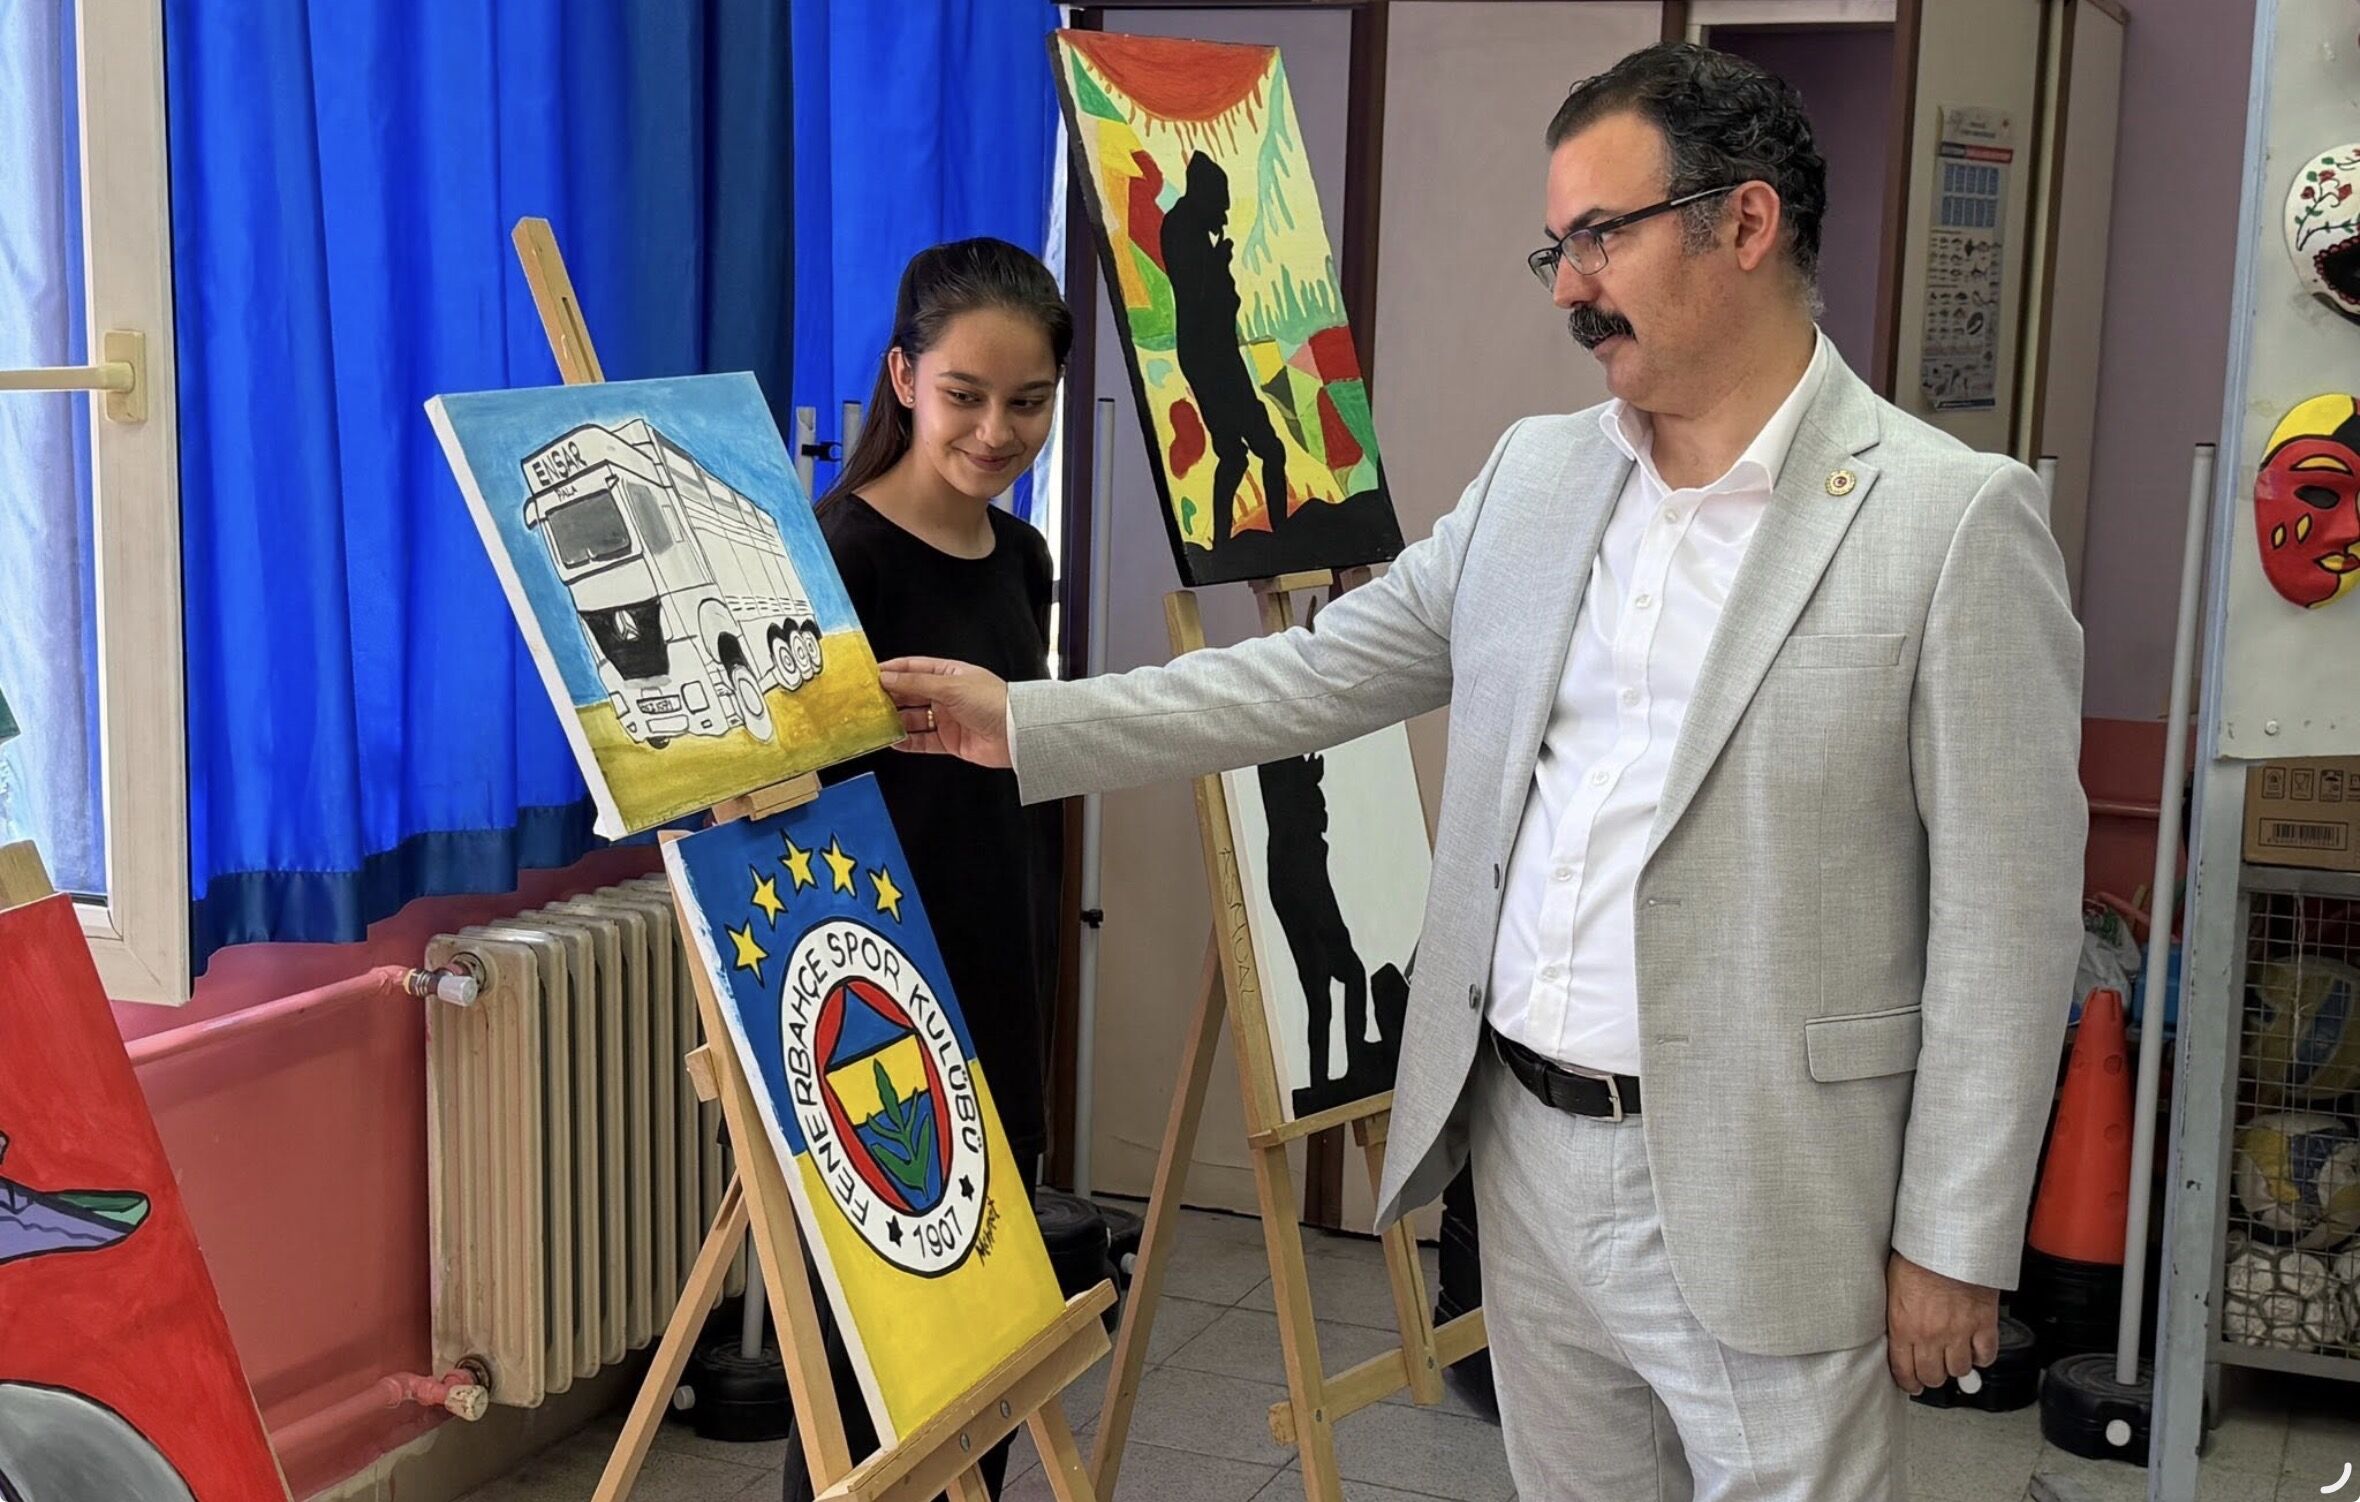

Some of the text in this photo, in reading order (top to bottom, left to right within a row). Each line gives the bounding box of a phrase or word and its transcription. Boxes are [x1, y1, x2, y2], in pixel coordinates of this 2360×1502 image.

[532, 441, 587, 486] ENSAR
[788, 932, 982, 1227] FENERBAHÇE SPOR KULÜBÜ
[912, 1207, 963, 1260] 1907
